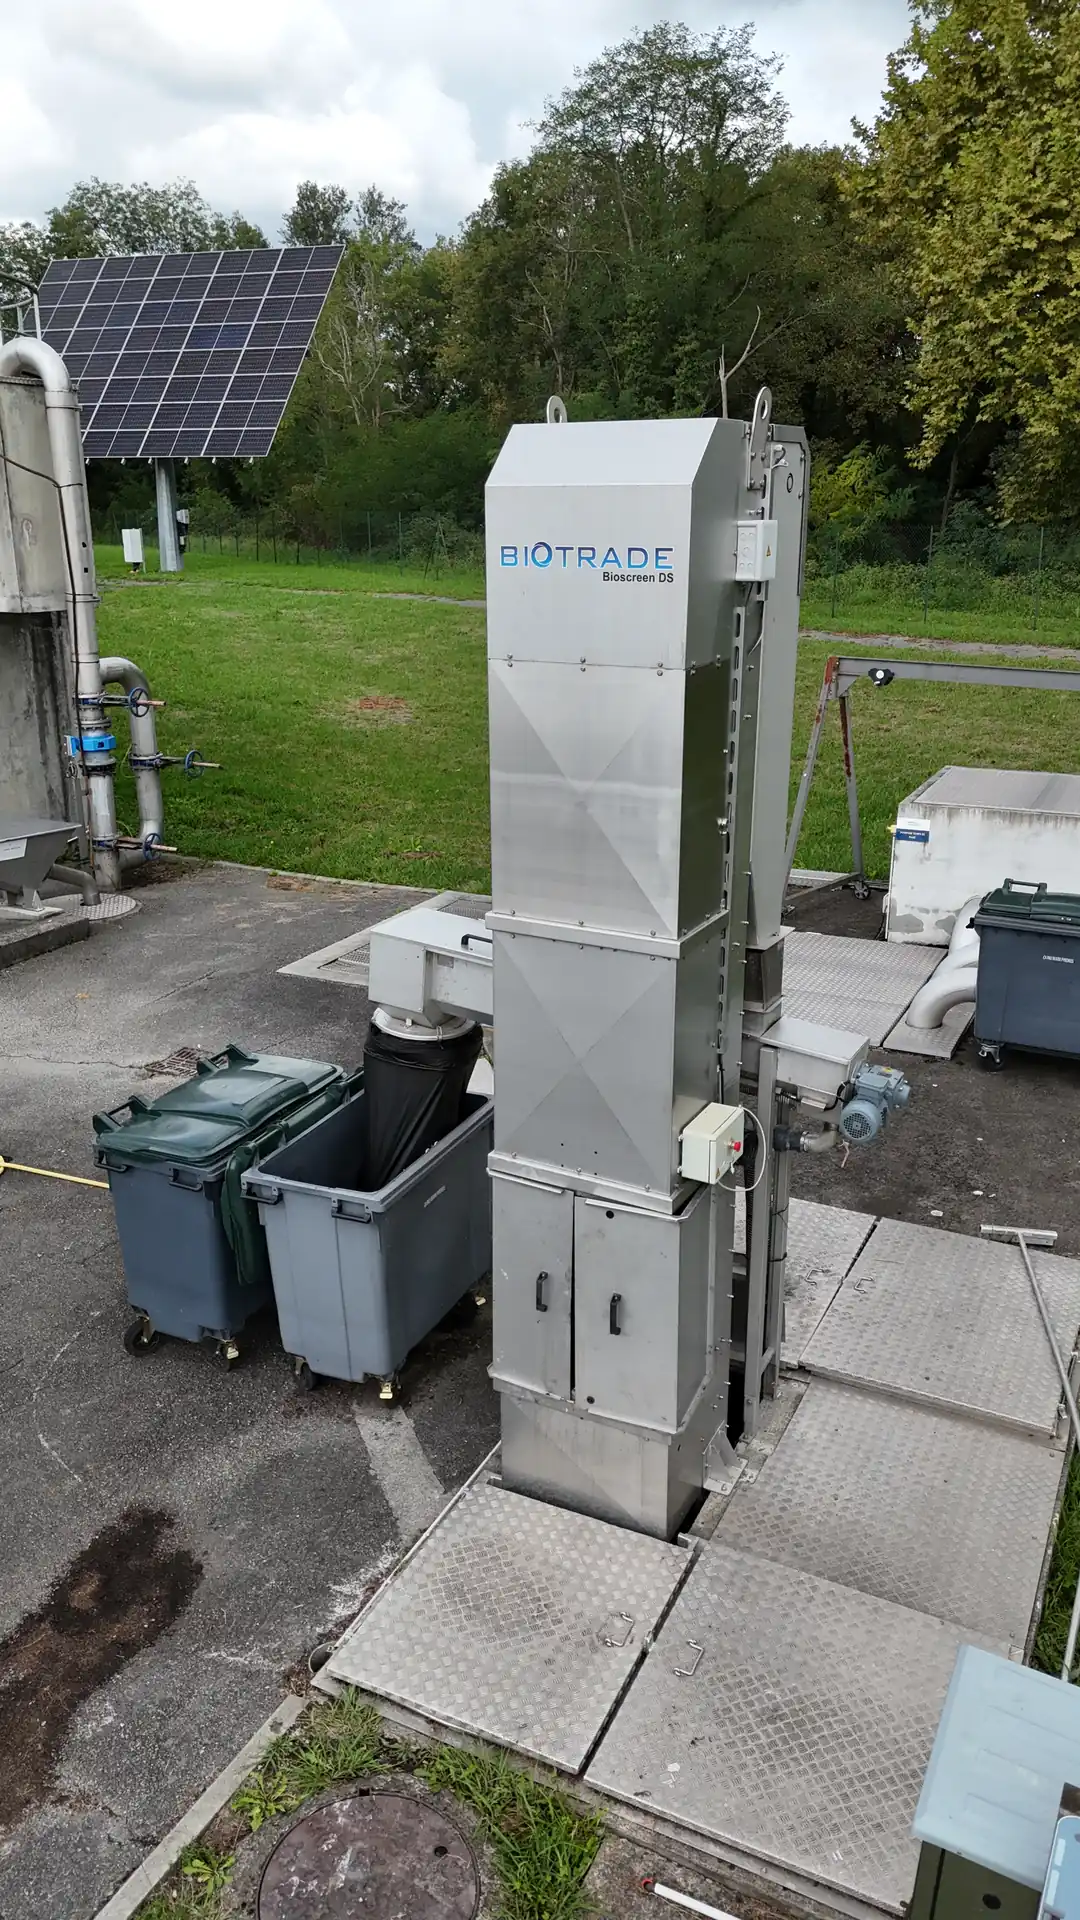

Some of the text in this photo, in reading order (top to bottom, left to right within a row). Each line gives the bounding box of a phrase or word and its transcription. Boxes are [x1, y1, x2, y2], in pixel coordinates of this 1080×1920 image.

[500, 541, 674, 569] BIOTRADE
[602, 572, 674, 583] Bioscreen DS
